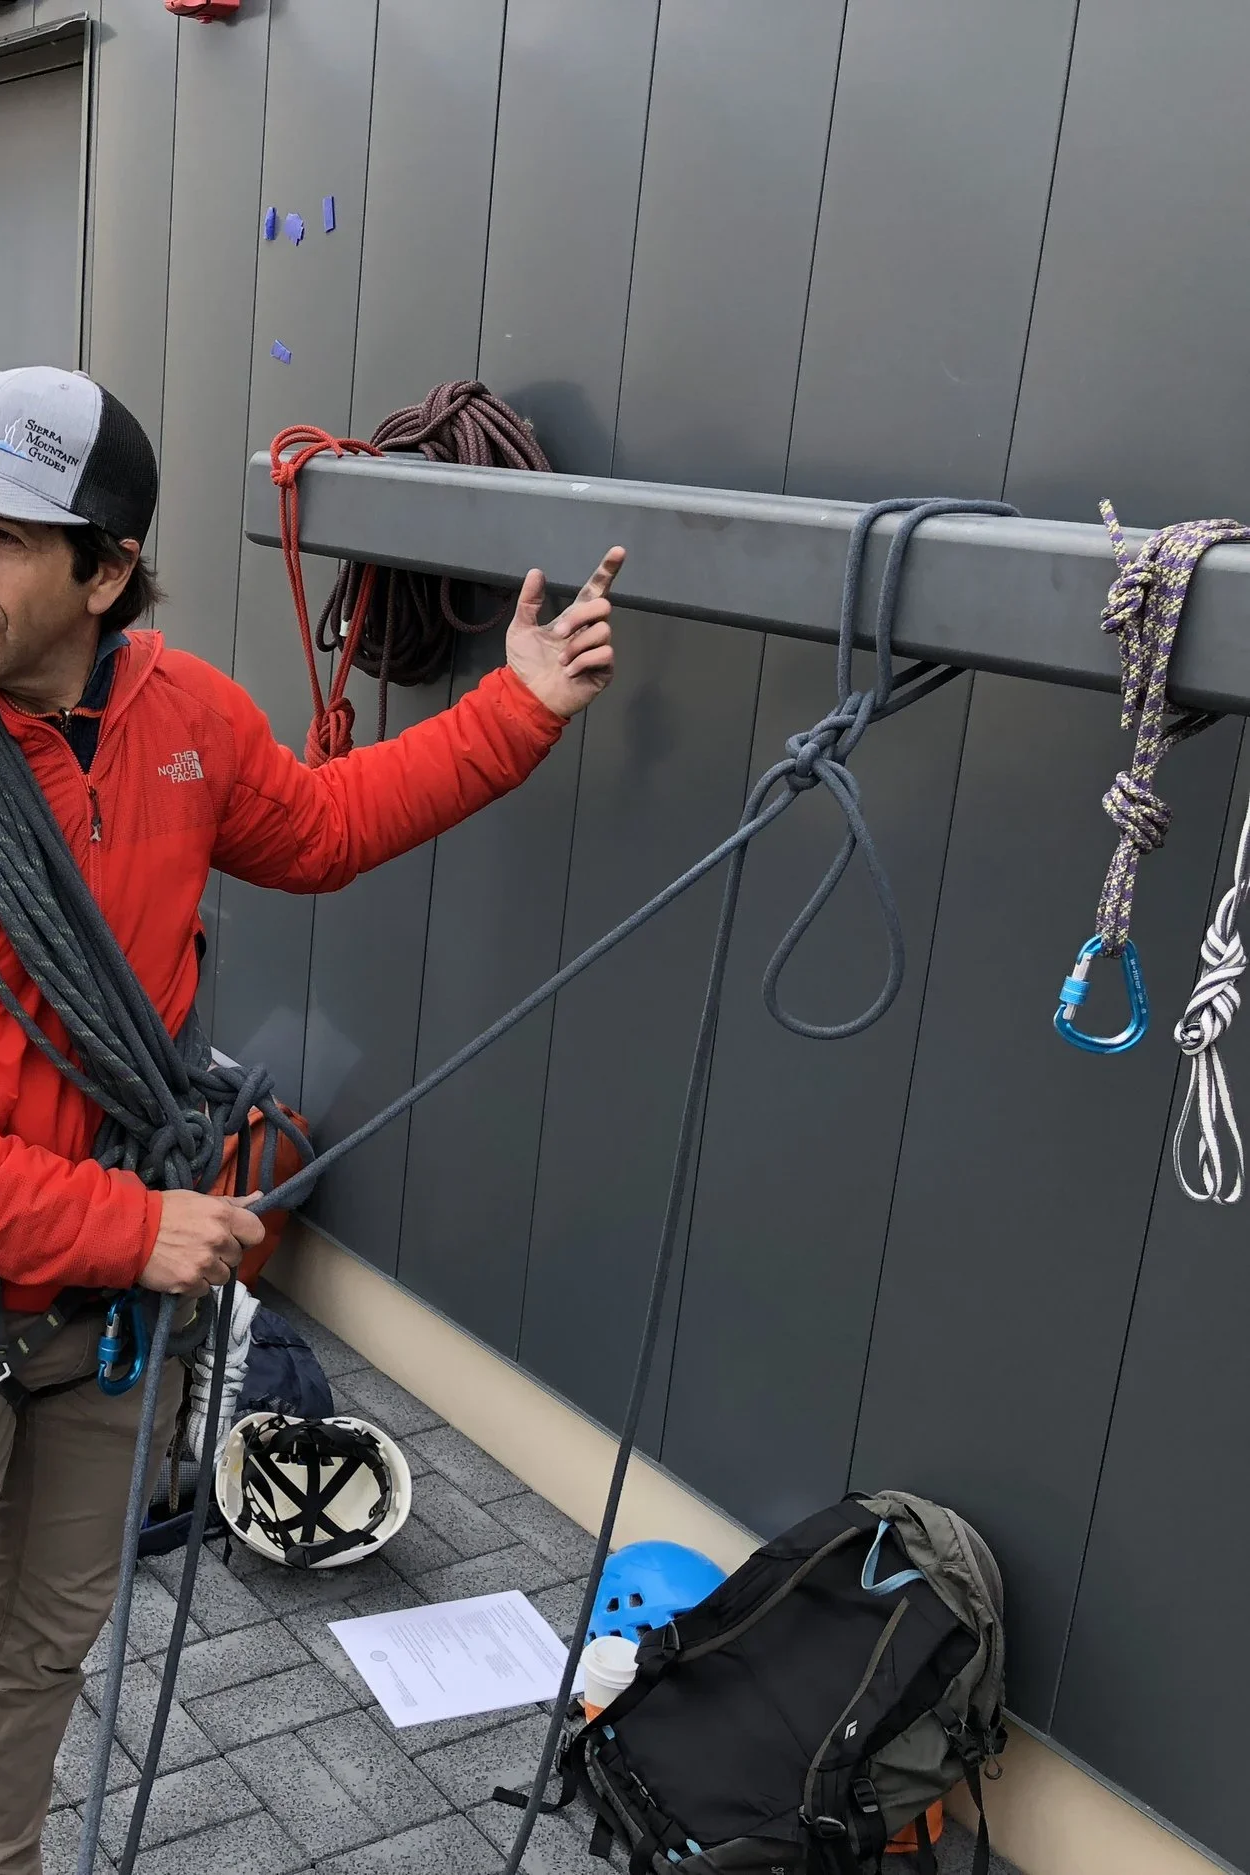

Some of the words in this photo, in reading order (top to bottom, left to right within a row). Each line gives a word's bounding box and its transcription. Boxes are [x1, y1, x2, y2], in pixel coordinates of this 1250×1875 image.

[25, 419, 62, 444] SIERRA
[26, 432, 79, 466] MOUNTAIN
[28, 447, 66, 473] GUIDES
[171, 751, 193, 763] THE
[158, 761, 195, 776] NORTH
[171, 770, 197, 784] FACE
